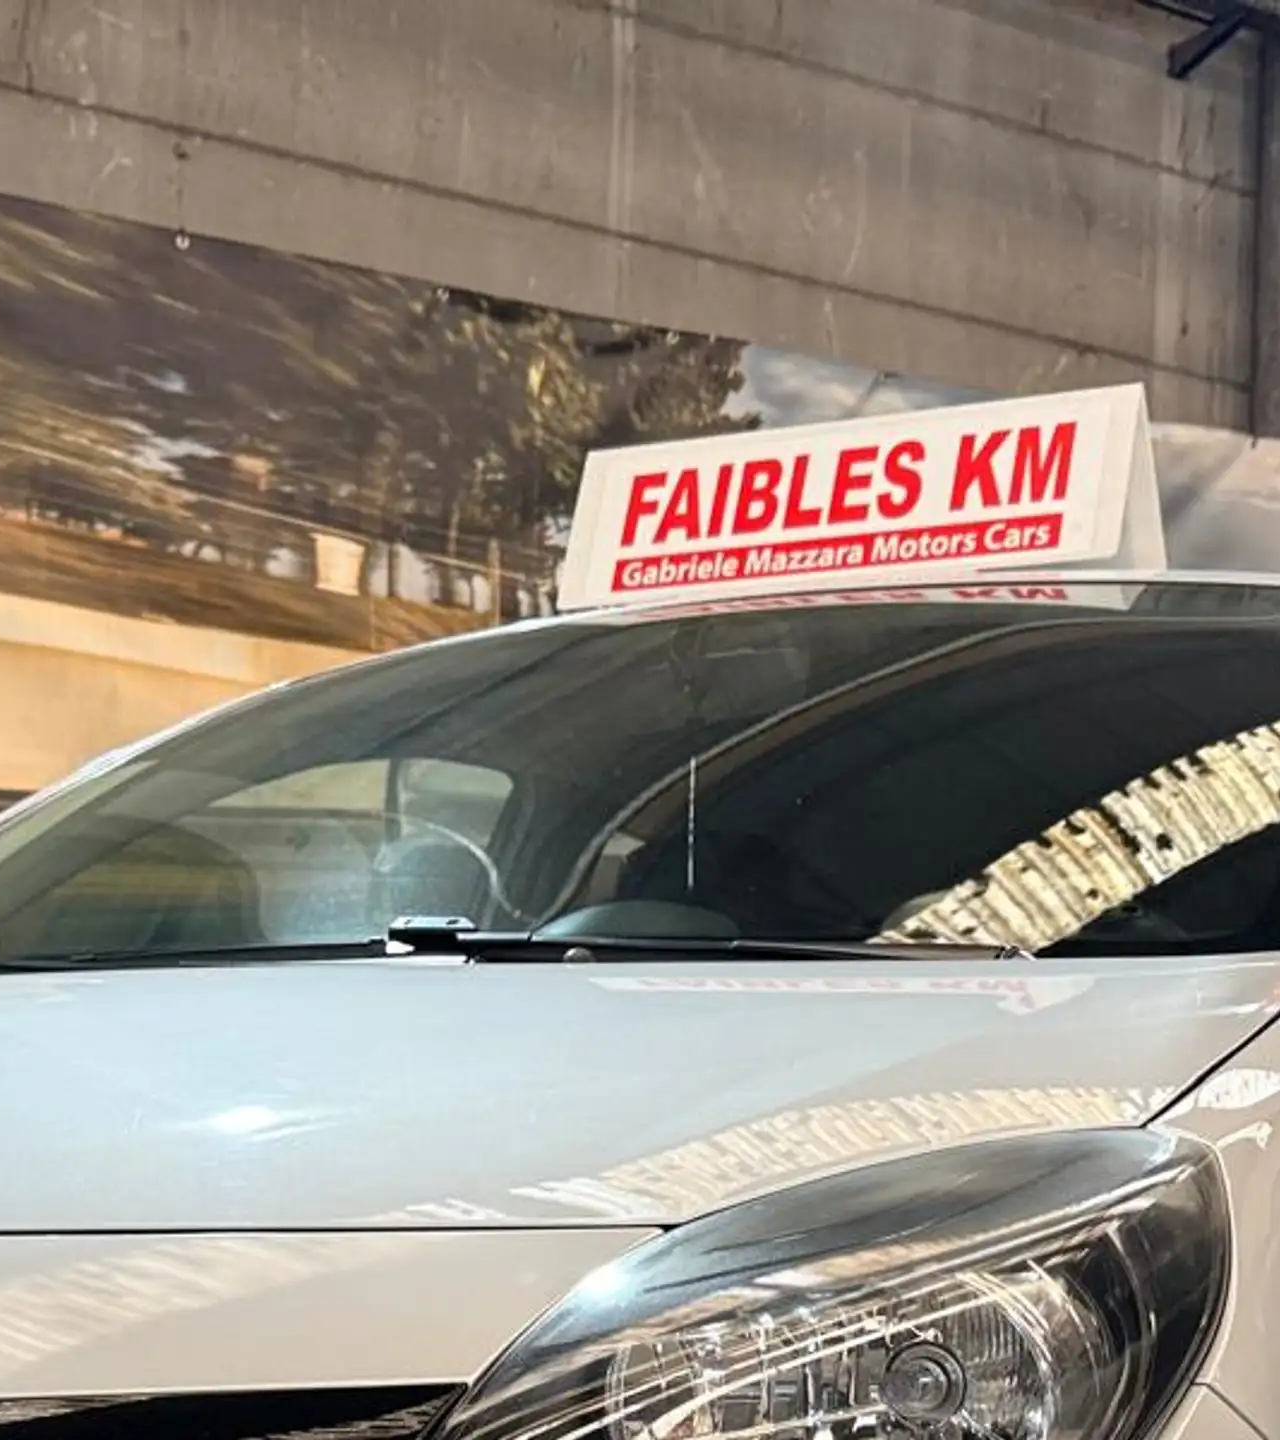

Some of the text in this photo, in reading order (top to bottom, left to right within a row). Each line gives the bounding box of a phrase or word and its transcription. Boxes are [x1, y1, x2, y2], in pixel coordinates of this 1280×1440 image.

[620, 421, 1078, 548] FAIBLES KM
[622, 518, 1052, 589] Gabriele Mazzara Motors Cars
